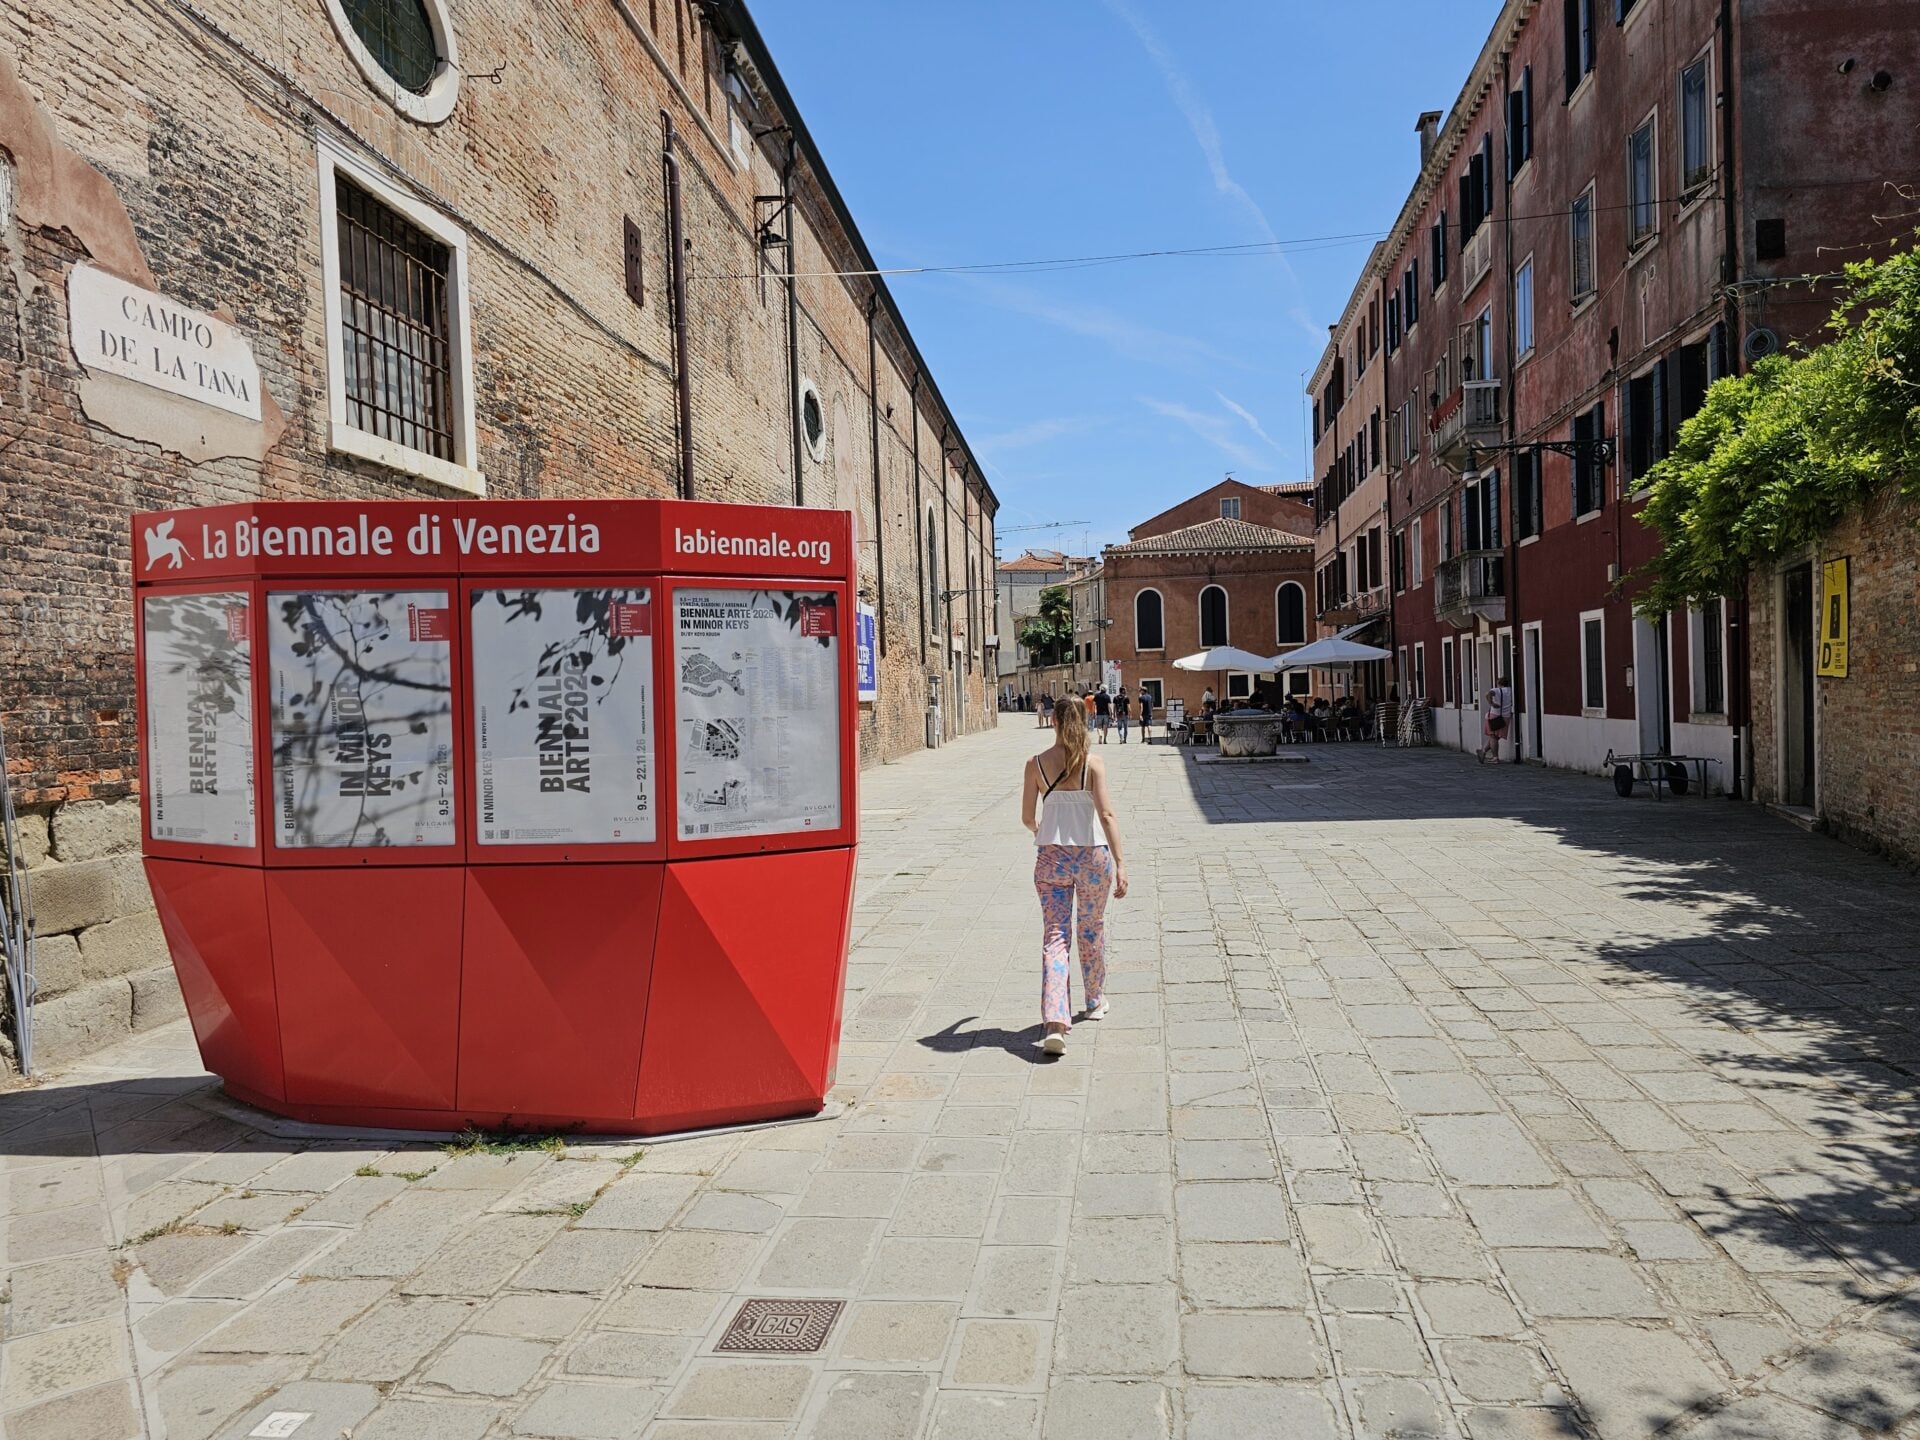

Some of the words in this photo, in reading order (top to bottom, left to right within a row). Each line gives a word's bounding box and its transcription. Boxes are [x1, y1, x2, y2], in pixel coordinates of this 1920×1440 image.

[122, 296, 213, 349] CAMPO
[101, 330, 138, 364] DE
[155, 347, 185, 381] LA
[194, 363, 249, 402] TANA
[203, 524, 227, 559] La
[236, 514, 393, 557] Biennale
[407, 514, 441, 555] di
[452, 513, 600, 555] Venezia
[675, 528, 831, 565] labiennale.org
[680, 608, 725, 619] BIENNALE
[727, 609, 751, 619] ARTE
[753, 609, 774, 619] 2026
[680, 620, 691, 629] IN
[693, 620, 723, 630] MINOR
[726, 620, 749, 630] KEYS
[187, 668, 204, 795] BIENNALE
[204, 730, 218, 796] ARTE
[366, 733, 392, 797] KEYS
[482, 750, 493, 776] KEYS
[564, 728, 590, 794] ARTE
[636, 739, 647, 781] 22.11.26
[340, 771, 363, 797] IN
[483, 778, 493, 810] MINOR
[157, 809, 163, 820] IN
[284, 778, 295, 830] BIENNALE
[438, 799, 448, 816] 9.5
[484, 812, 494, 823] IN
[637, 794, 647, 811] 9.5
[760, 1317, 802, 1334] GAS
